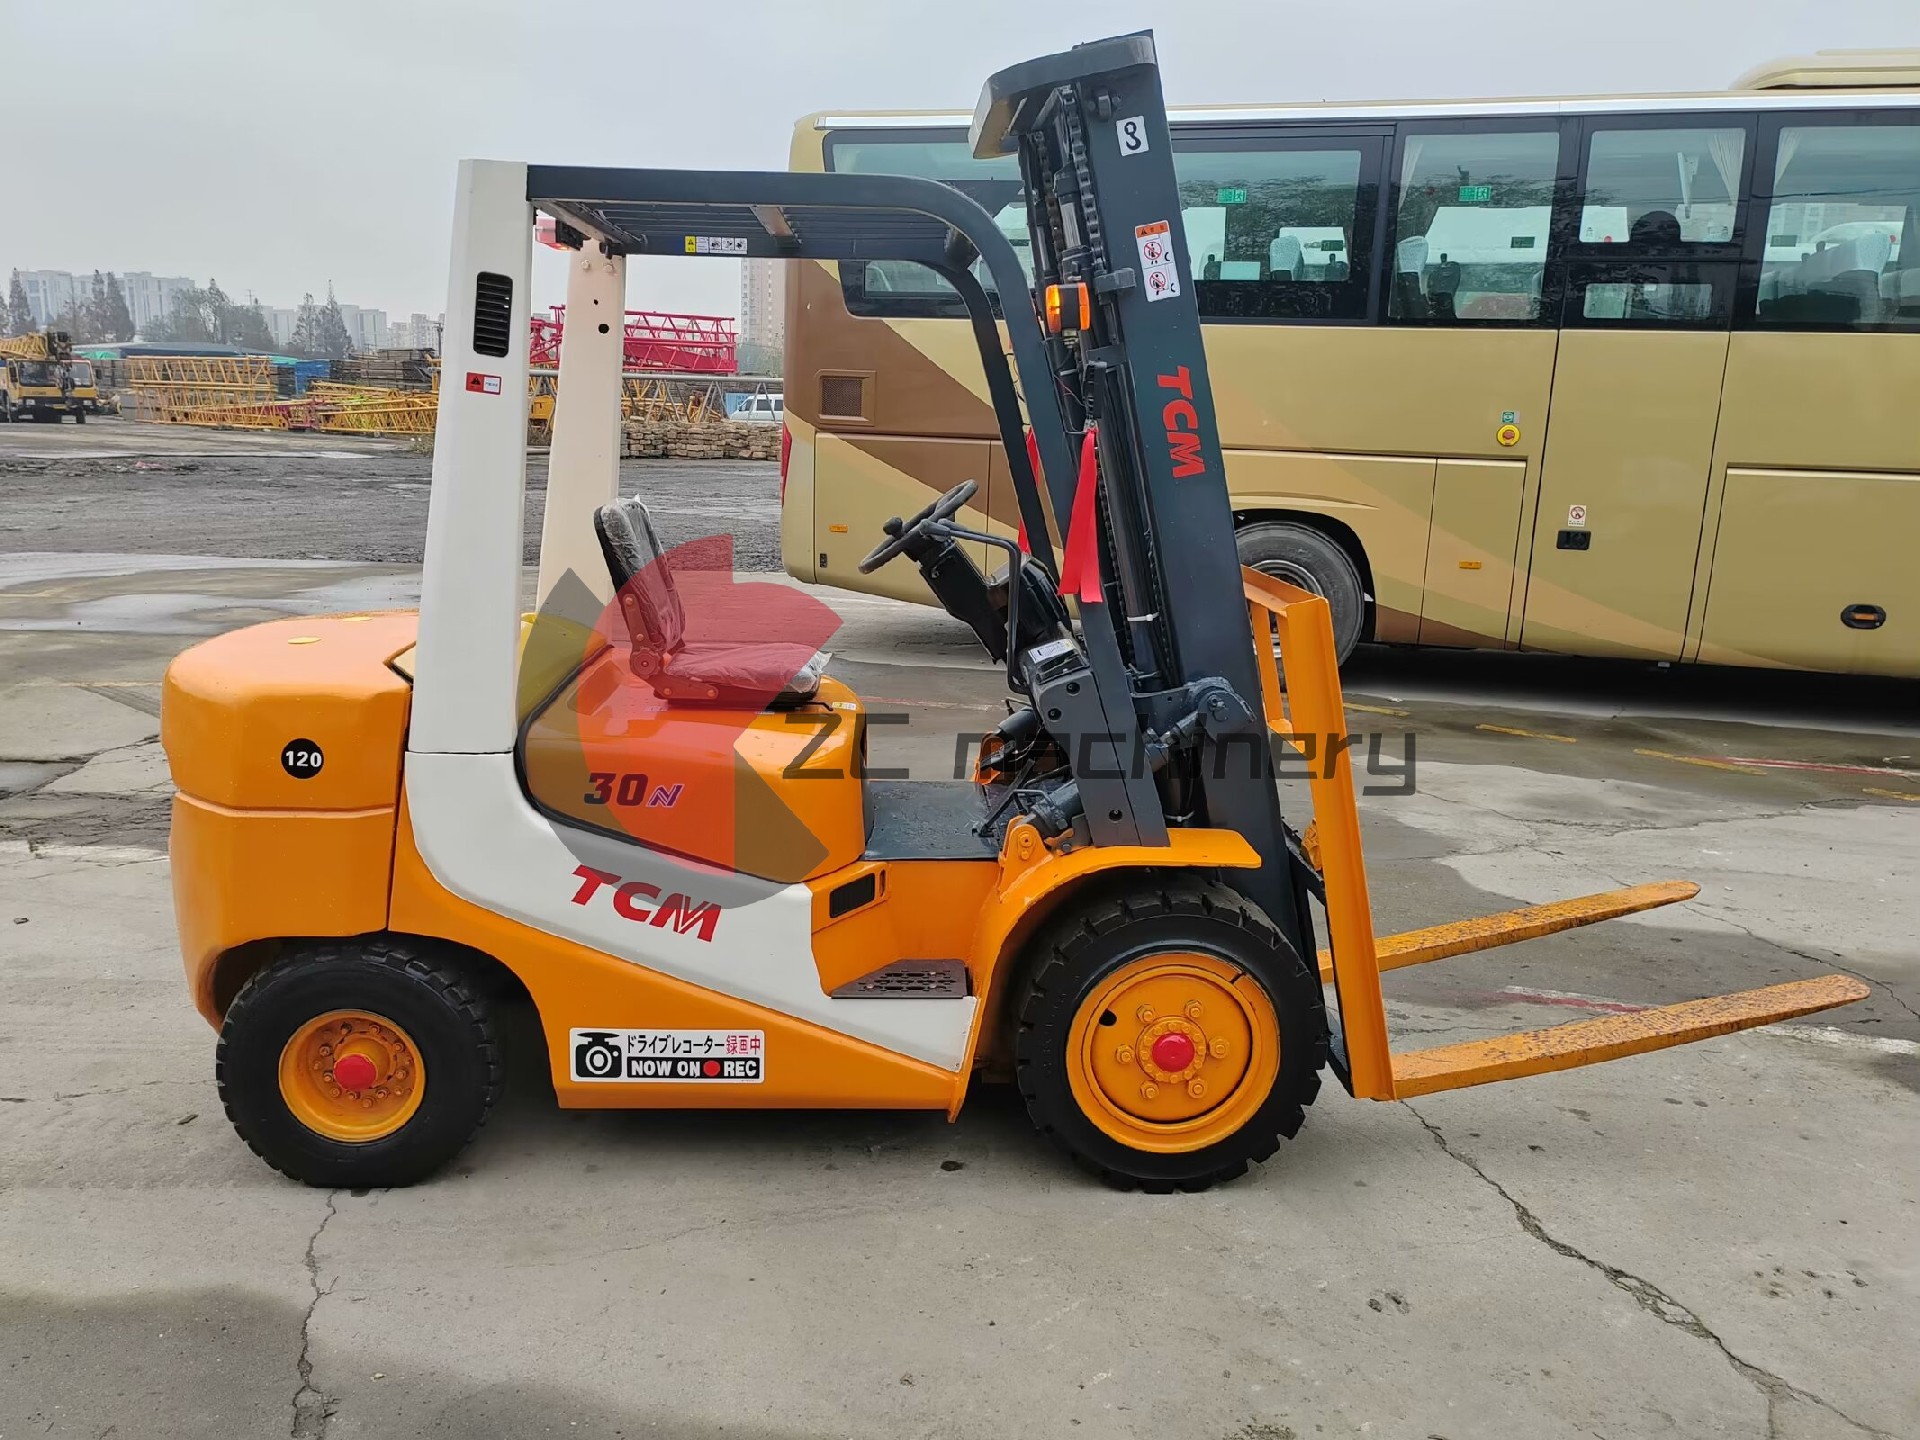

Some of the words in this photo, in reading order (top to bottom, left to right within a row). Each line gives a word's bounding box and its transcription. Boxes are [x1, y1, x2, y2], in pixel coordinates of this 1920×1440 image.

[1157, 365, 1206, 478] TCM
[285, 750, 322, 768] 120
[571, 864, 722, 942] TCM
[631, 1060, 672, 1078] NOW
[676, 1060, 700, 1078] ON
[723, 1060, 757, 1077] REC
